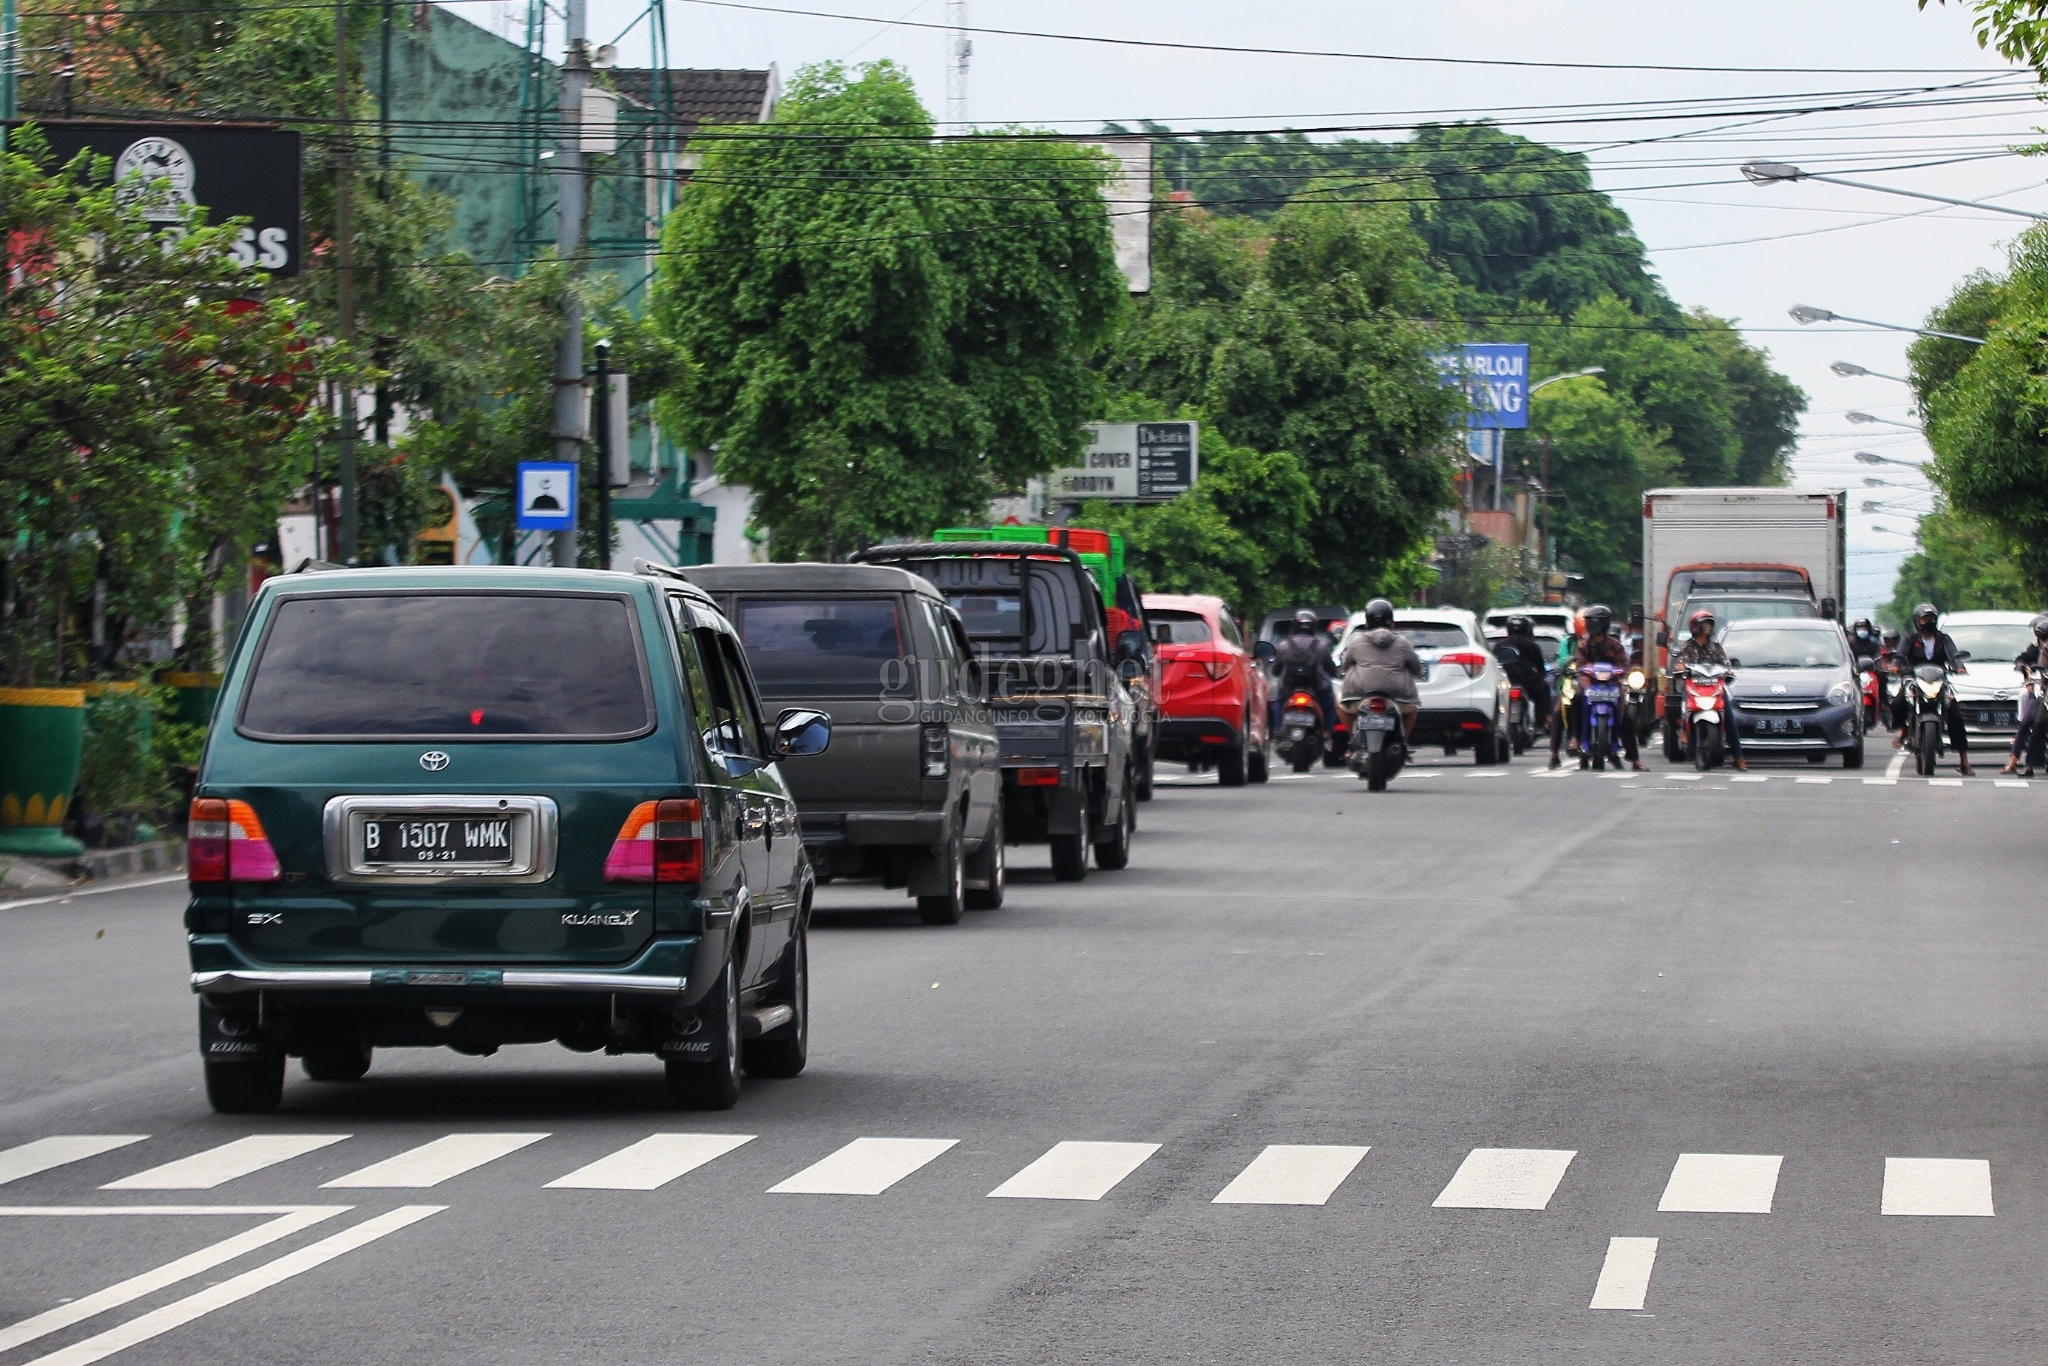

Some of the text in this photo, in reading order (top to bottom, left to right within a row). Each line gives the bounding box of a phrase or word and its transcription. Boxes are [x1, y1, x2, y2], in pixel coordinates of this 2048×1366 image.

[1463, 355, 1523, 376] ARLOJI
[1089, 453, 1131, 468] COVER
[366, 821, 508, 849] B 1507 WMK
